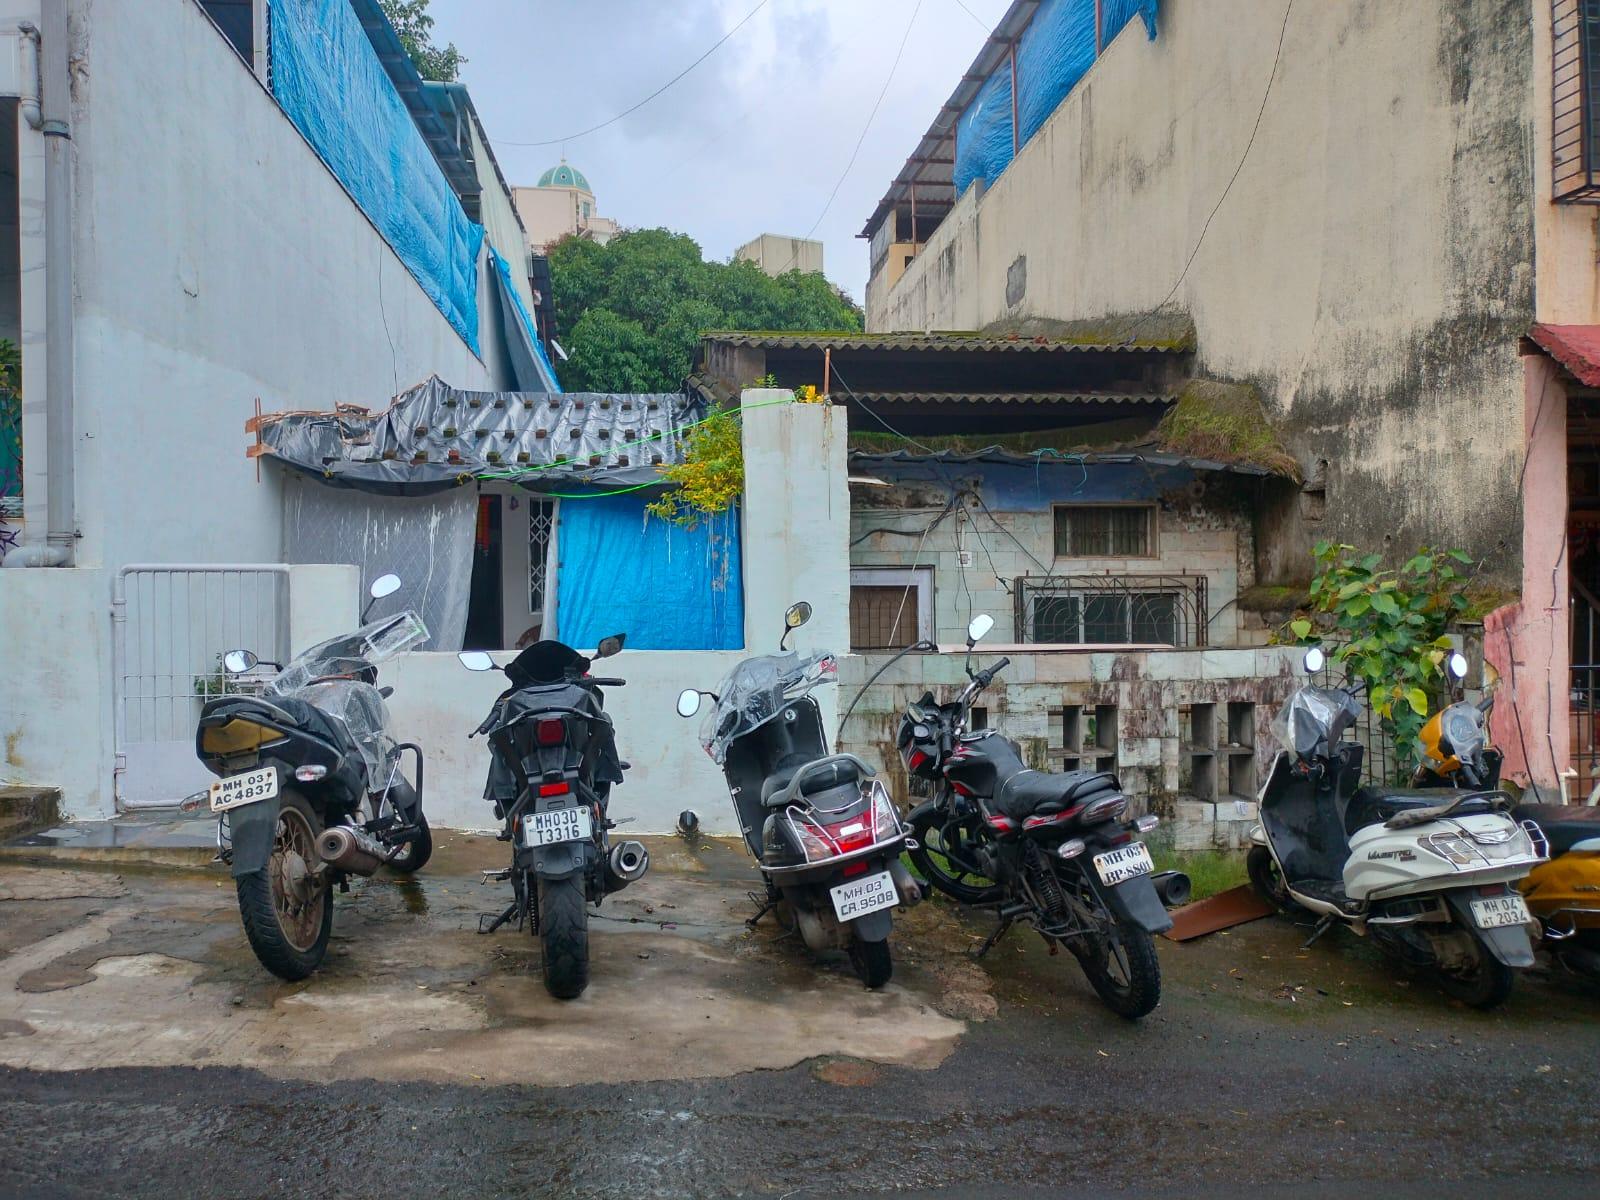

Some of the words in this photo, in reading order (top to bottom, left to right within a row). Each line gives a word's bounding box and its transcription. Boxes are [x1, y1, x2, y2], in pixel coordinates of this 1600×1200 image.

[223, 780, 242, 792] MH
[248, 774, 264, 785] 03
[535, 810, 578, 830] MH03D
[537, 824, 580, 844] T3316
[1482, 900, 1499, 913] MH
[1501, 898, 1518, 911] 04
[1496, 910, 1528, 924] 2034
